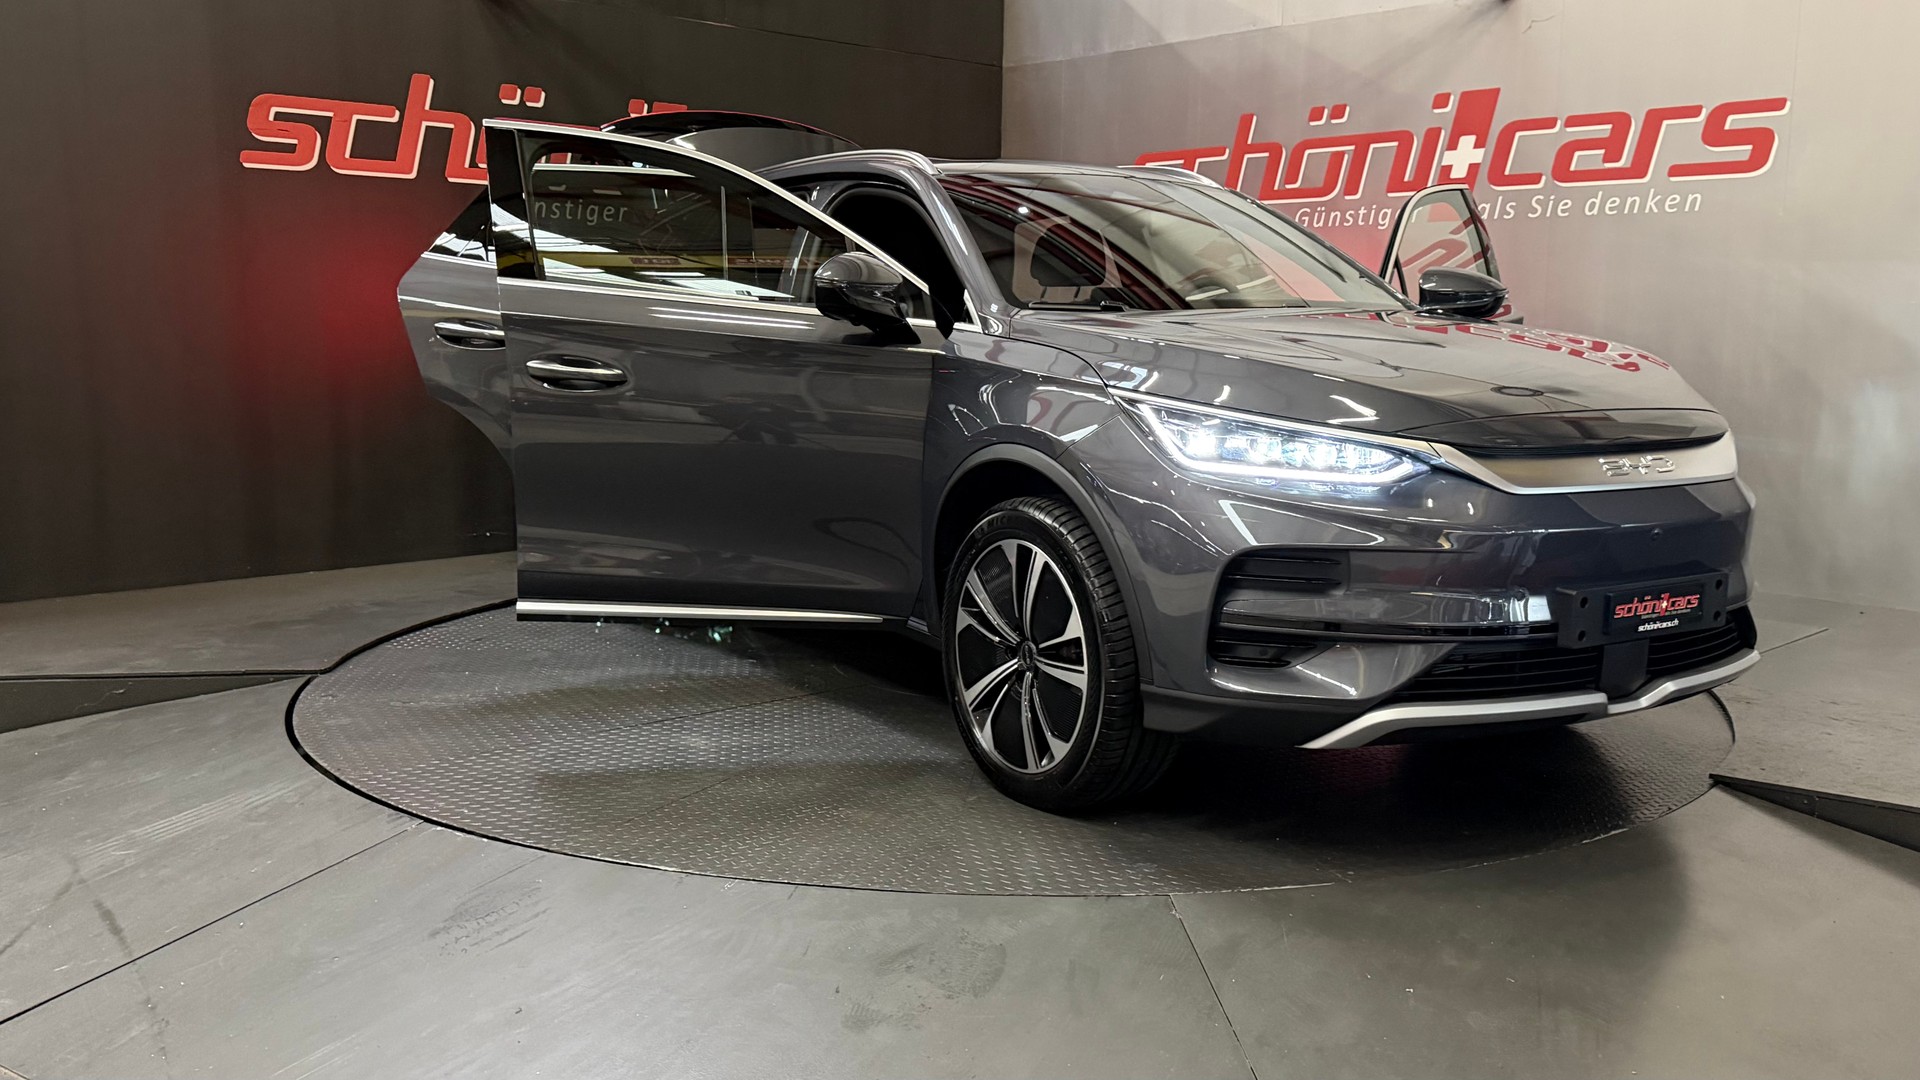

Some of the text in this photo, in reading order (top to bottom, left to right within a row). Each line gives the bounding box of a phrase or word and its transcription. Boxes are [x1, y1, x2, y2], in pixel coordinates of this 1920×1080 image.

[533, 198, 628, 226] nstiger
[1295, 188, 1703, 230] Günstigr als Sie denken
[1599, 455, 1675, 477] BYD
